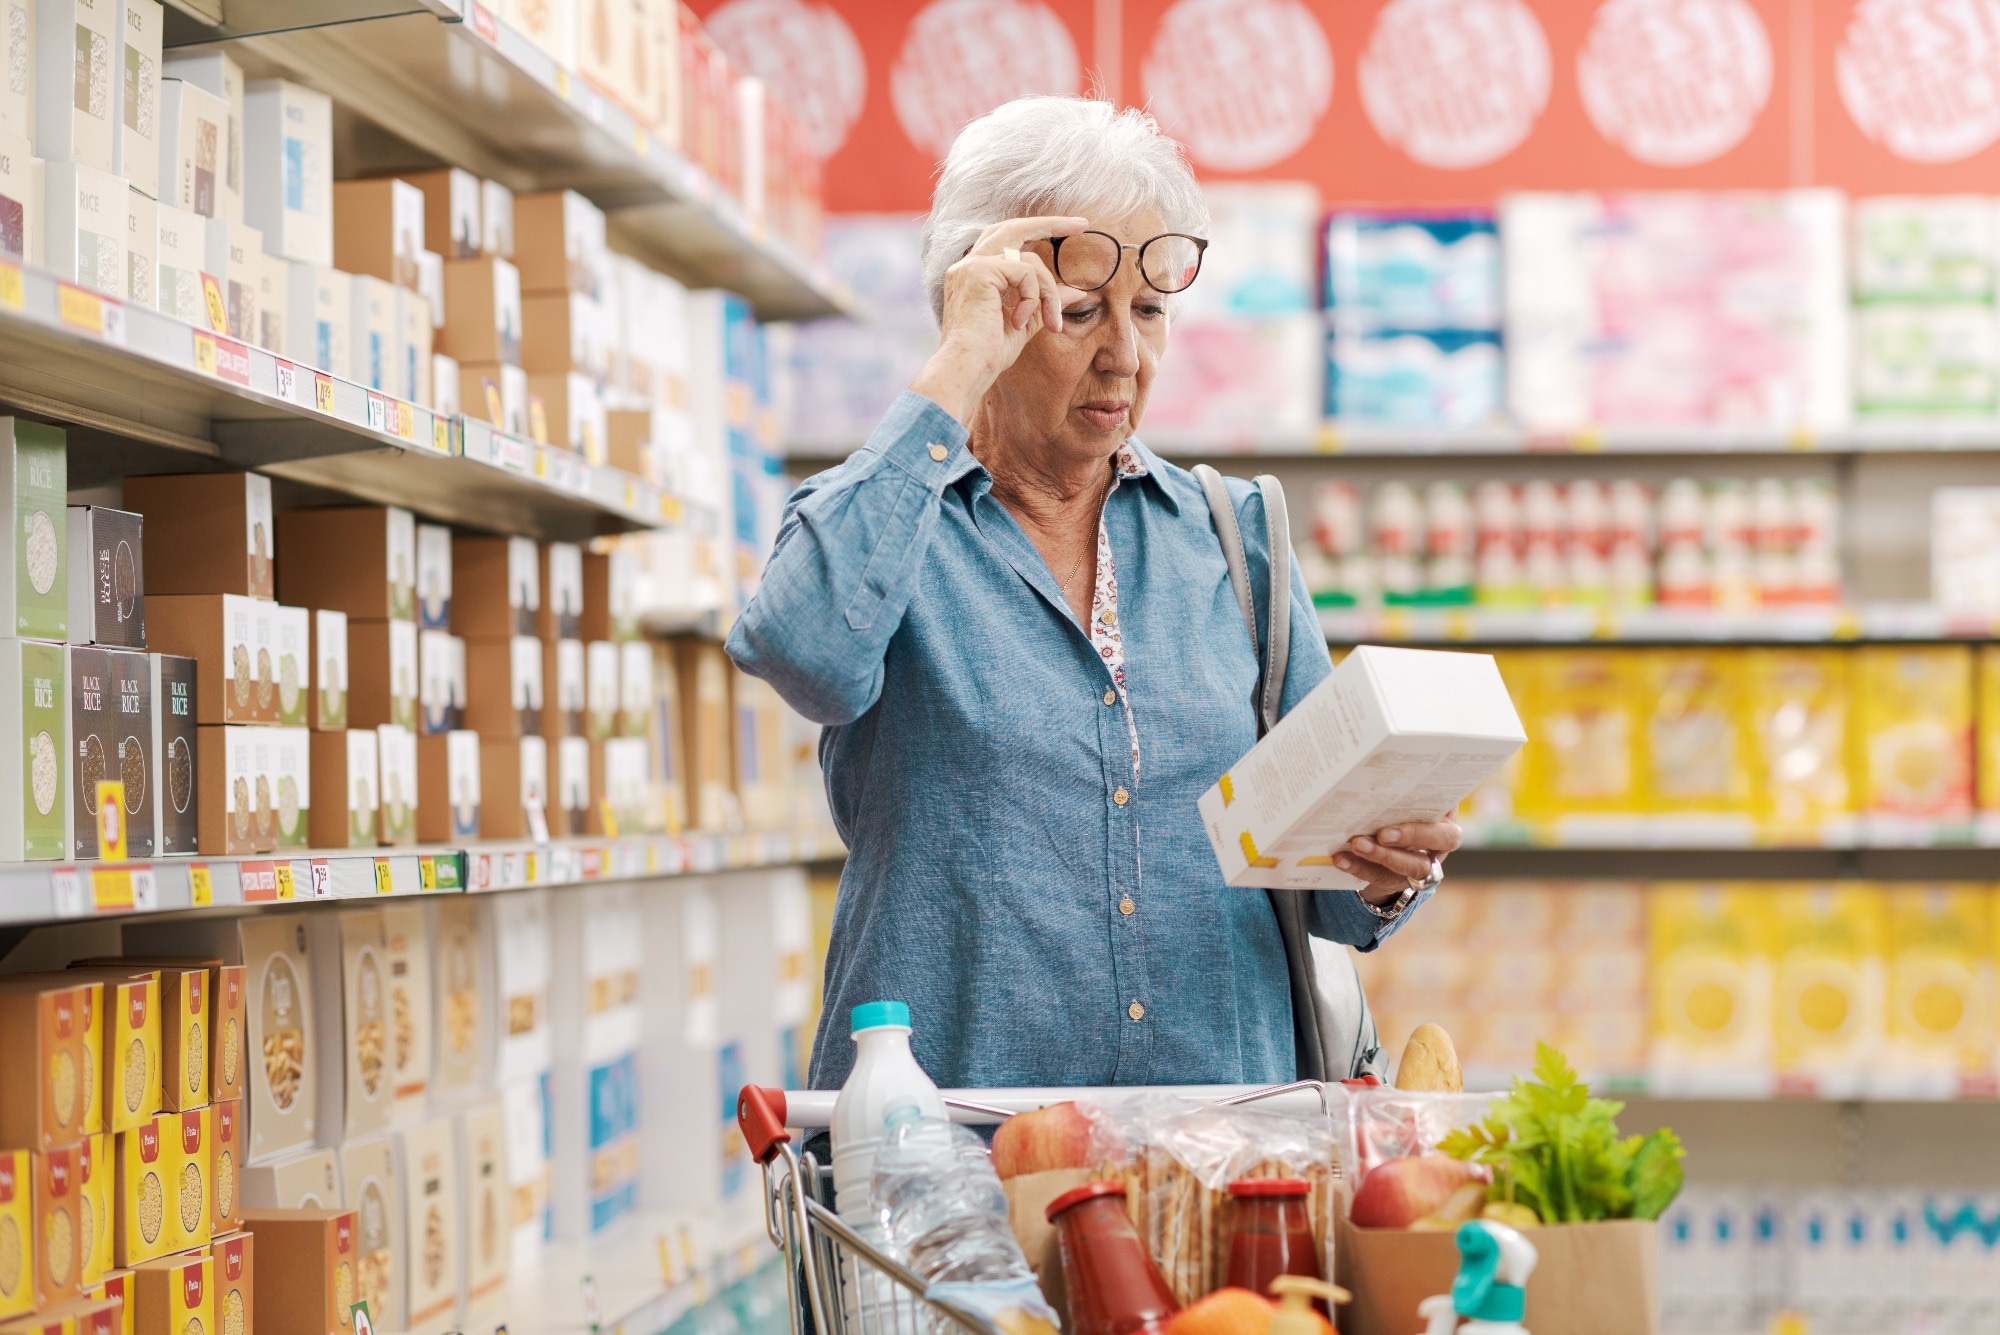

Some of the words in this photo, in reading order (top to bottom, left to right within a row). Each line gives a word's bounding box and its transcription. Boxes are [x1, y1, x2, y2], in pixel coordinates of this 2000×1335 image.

[127, 7, 142, 32] RICE
[79, 190, 100, 213] RICE
[160, 227, 178, 249] RICE
[230, 244, 243, 264] RICE
[30, 466, 52, 489] RICE
[82, 675, 100, 691] BLACK
[120, 679, 139, 694] BLACK
[171, 681, 187, 697] BLACK
[34, 687, 53, 708] RICE
[83, 692, 102, 711] RICE
[121, 695, 140, 713] RICE
[171, 696, 188, 715] RICE
[144, 1134, 155, 1146] Pasta
[186, 1126, 197, 1137] Pasta
[229, 1253, 239, 1265] Pasta
[188, 1280, 199, 1291] Pasta
